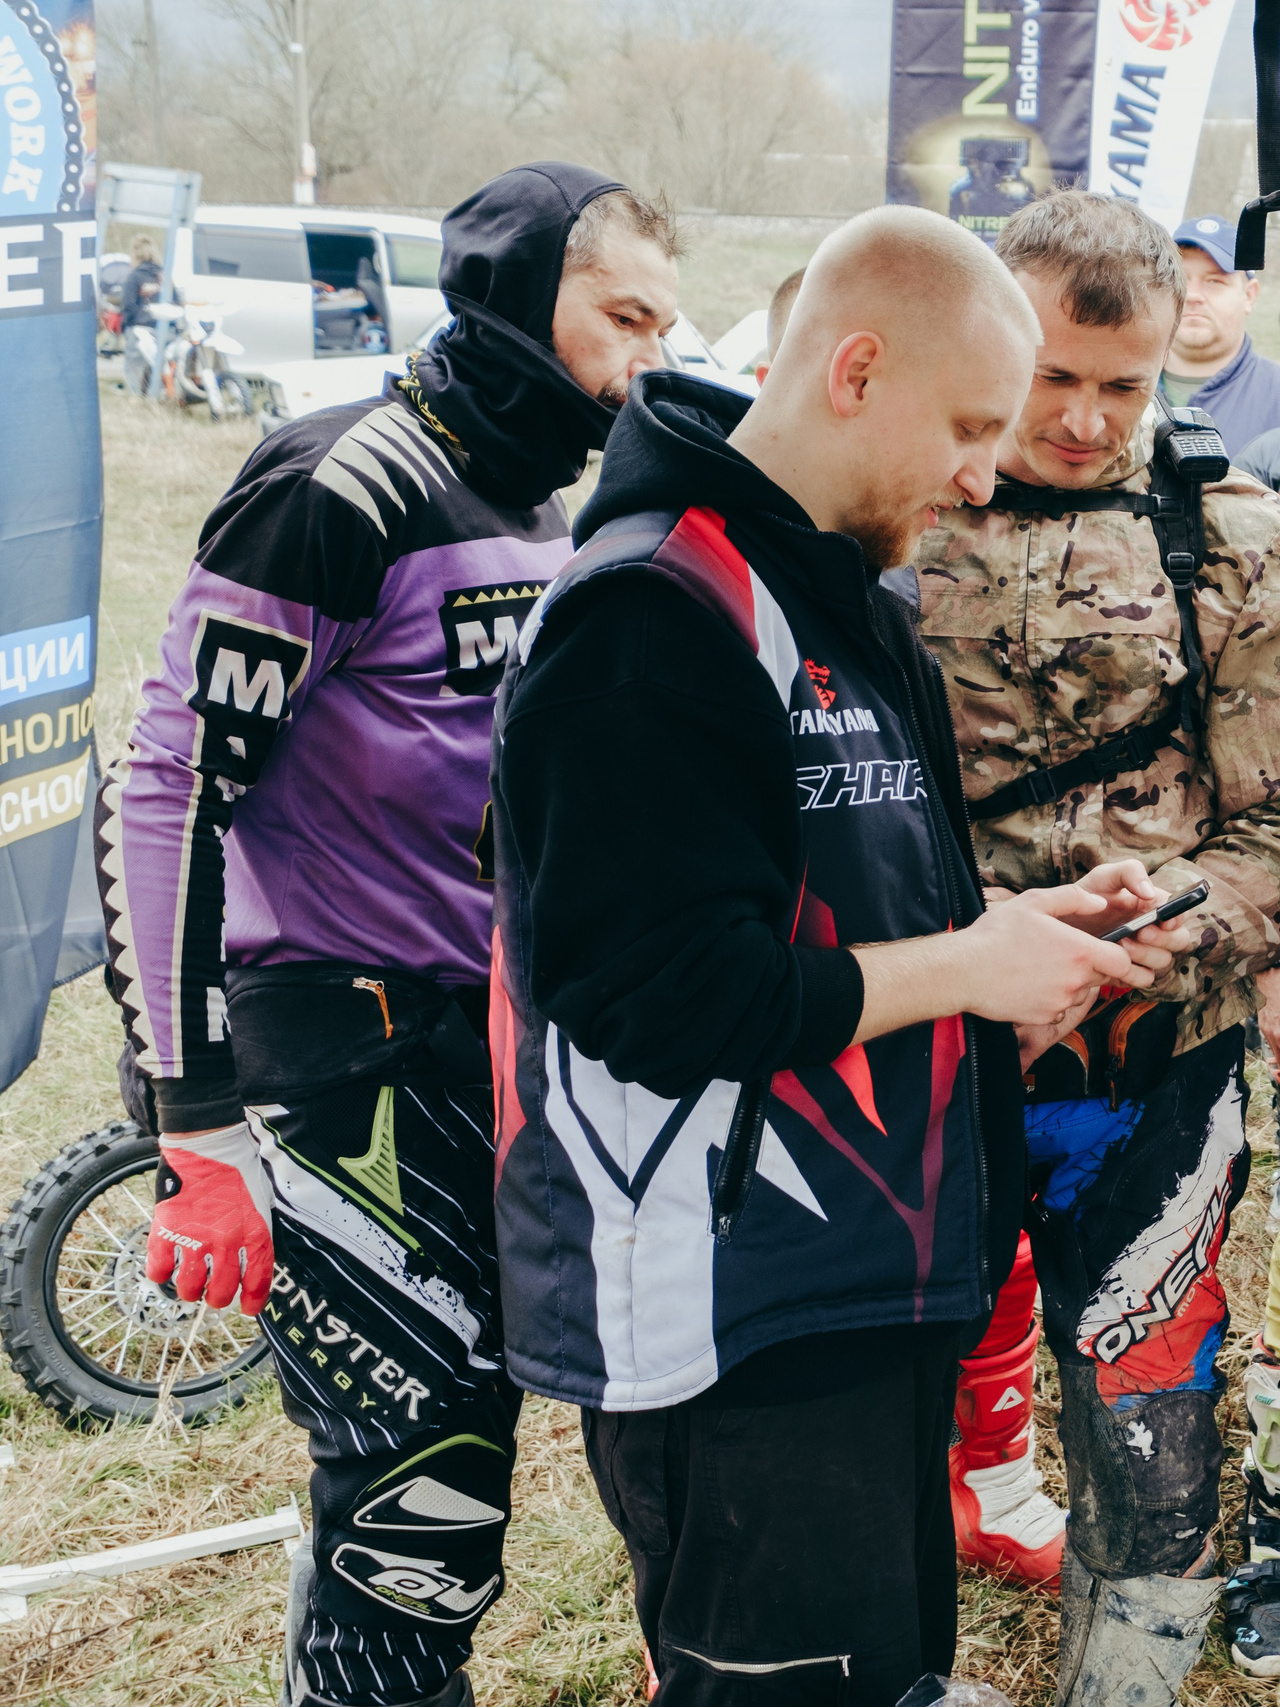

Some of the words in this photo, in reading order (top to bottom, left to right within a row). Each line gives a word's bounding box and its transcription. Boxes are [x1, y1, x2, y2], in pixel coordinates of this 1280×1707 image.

[1015, 18, 1040, 118] Enduro
[157, 1225, 204, 1252] THOR
[264, 1300, 377, 1409] NERGY
[270, 1260, 431, 1423] ONSTER
